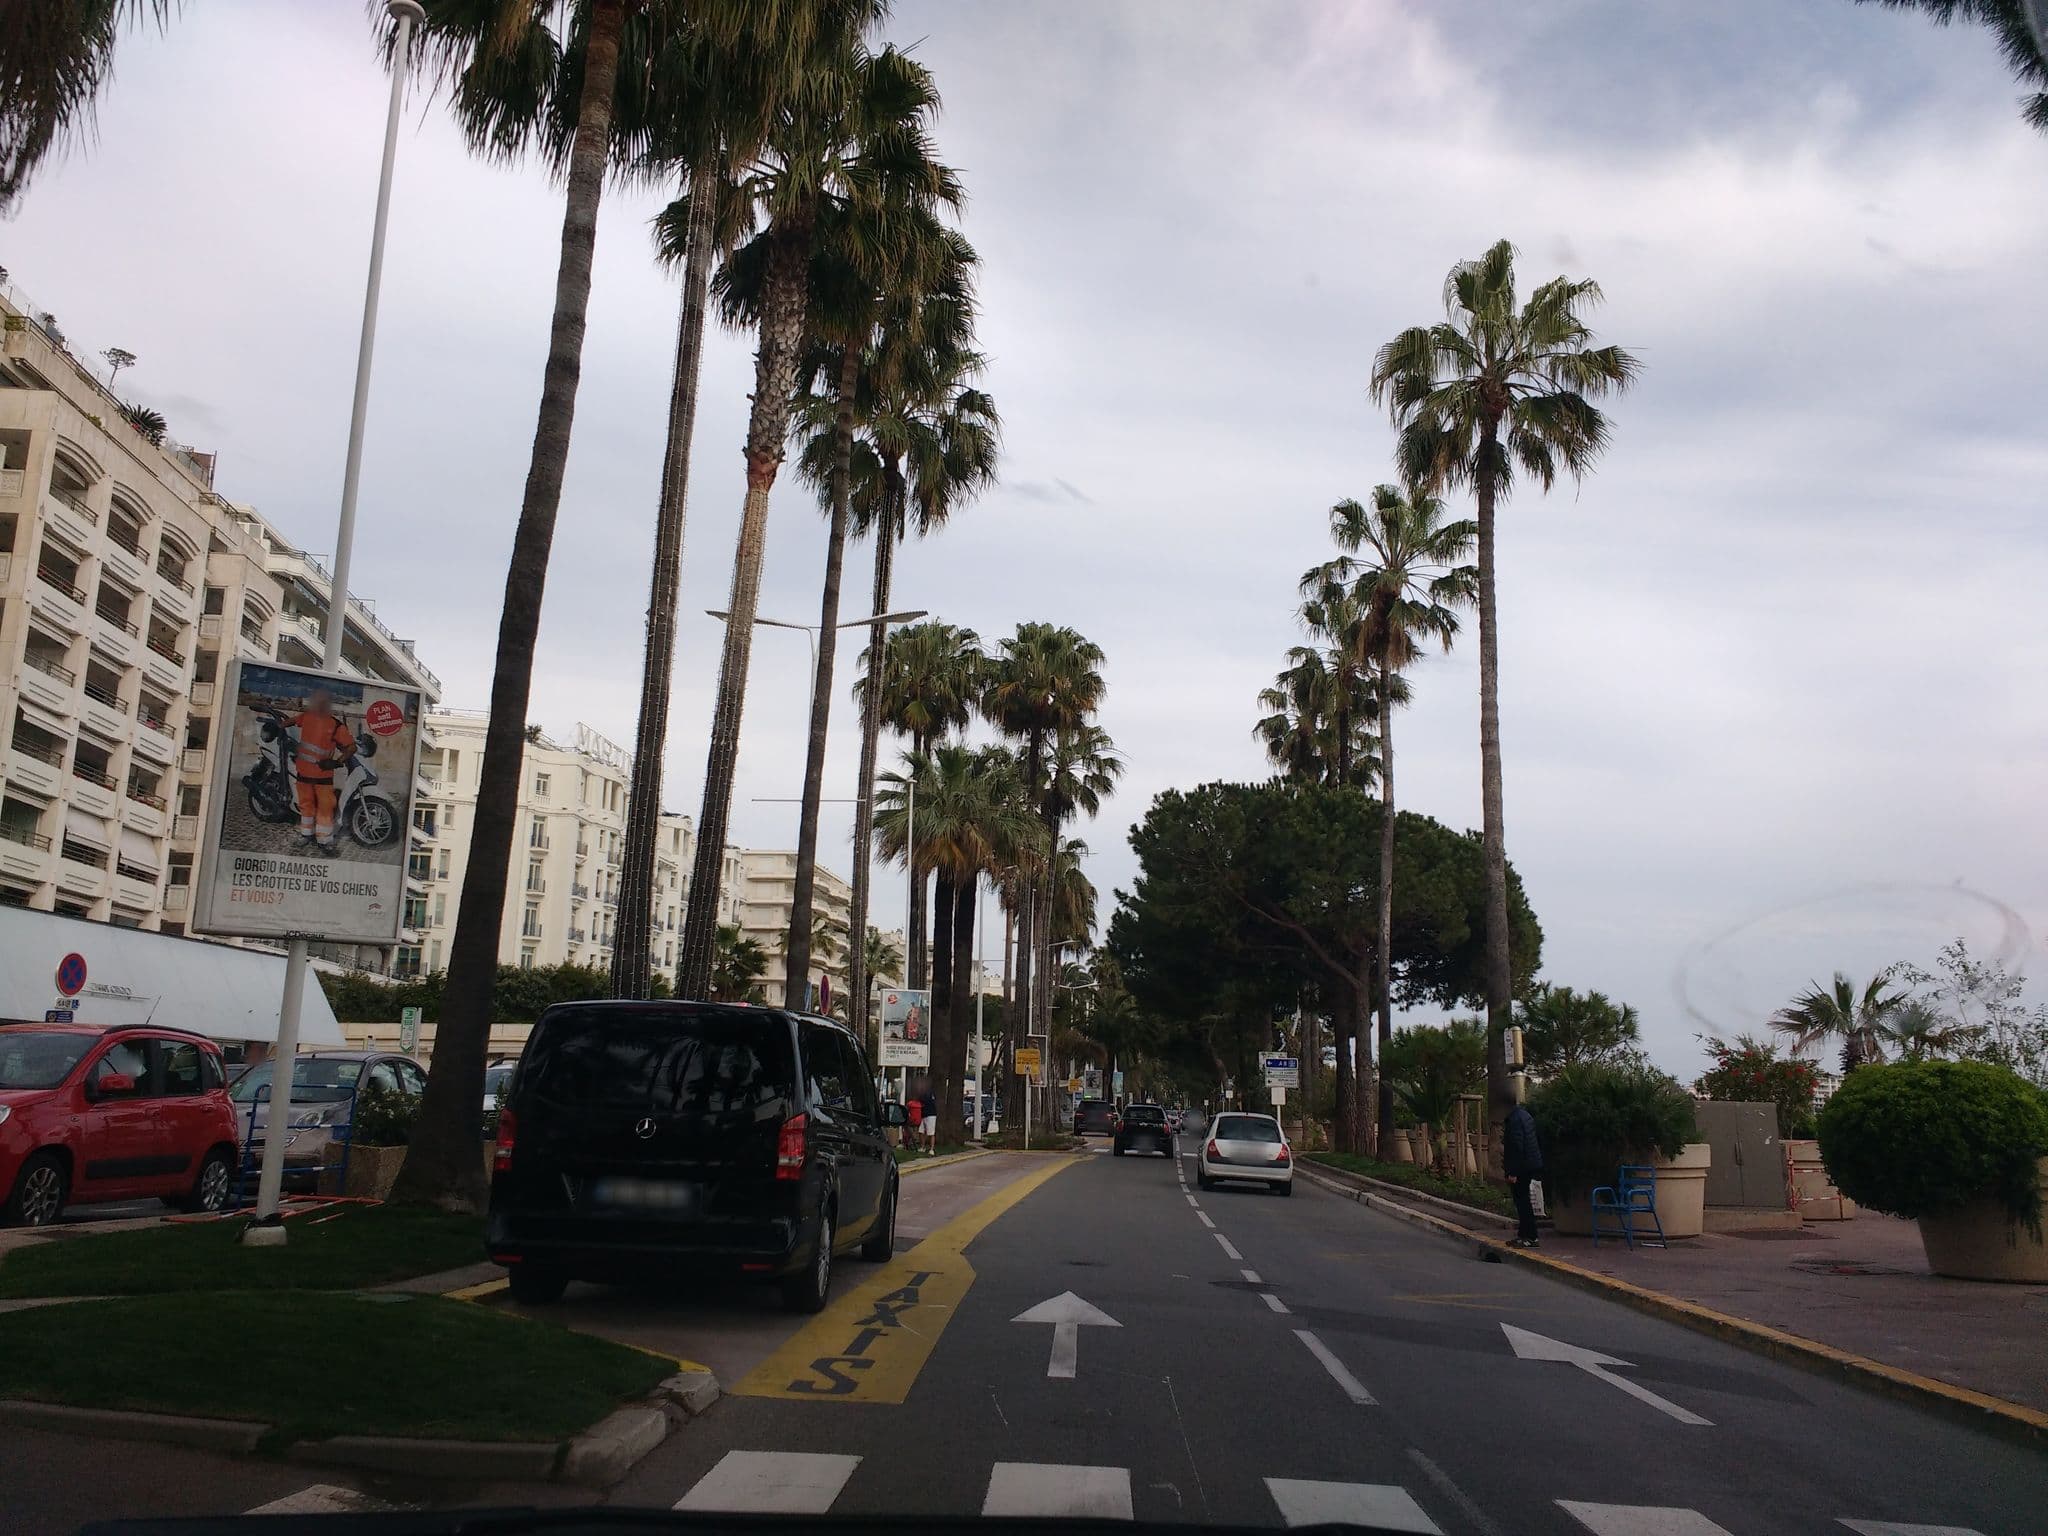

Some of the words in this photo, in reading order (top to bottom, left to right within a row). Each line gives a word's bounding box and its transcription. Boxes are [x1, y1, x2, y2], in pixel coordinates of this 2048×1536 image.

[373, 704, 391, 714] PLAN
[234, 857, 277, 873] GIORGIO
[279, 861, 329, 878] RAMASSE
[232, 873, 253, 887] LES
[255, 875, 301, 891] CROTTES
[304, 879, 317, 892] DE
[320, 881, 340, 894] VOS
[342, 883, 378, 897] CHIENS
[231, 889, 245, 902] ET
[247, 890, 274, 904] VOUS
[278, 892, 285, 904] ?
[284, 930, 326, 940] JCDecaux
[787, 1271, 944, 1394] TAXIS
